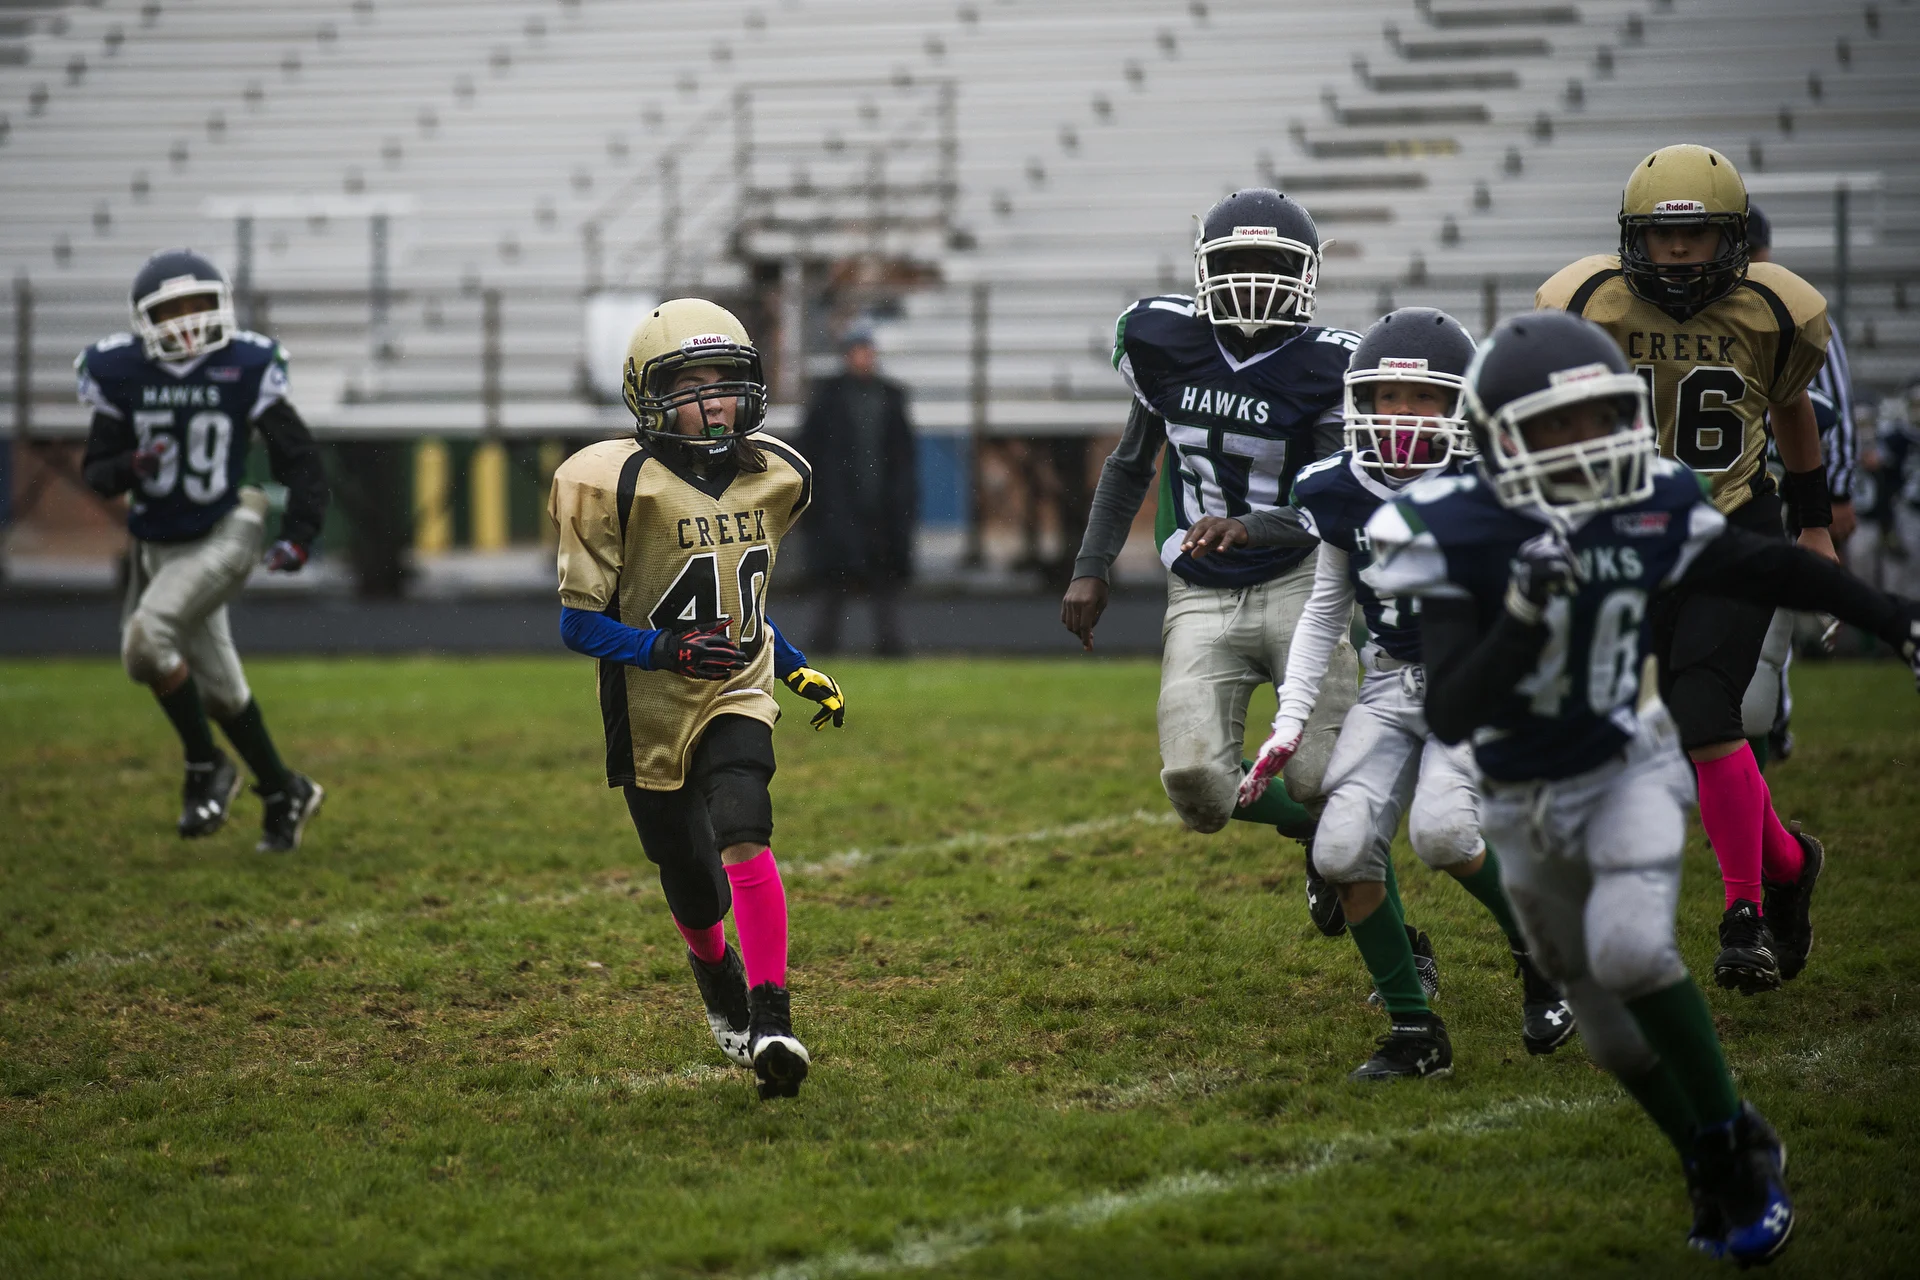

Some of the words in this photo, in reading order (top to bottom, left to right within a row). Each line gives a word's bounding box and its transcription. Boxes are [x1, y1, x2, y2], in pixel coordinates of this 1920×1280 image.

[1665, 203, 1694, 211] Riddell
[692, 336, 722, 346] Riddell
[1628, 332, 1737, 364] CREEK
[1389, 361, 1418, 369] Riddell
[142, 386, 221, 407] HAWKS
[1180, 386, 1270, 424] HAWKS
[133, 412, 234, 503] 59
[1165, 419, 1288, 526] 57
[677, 509, 766, 549] CREEK
[648, 545, 771, 664] 40
